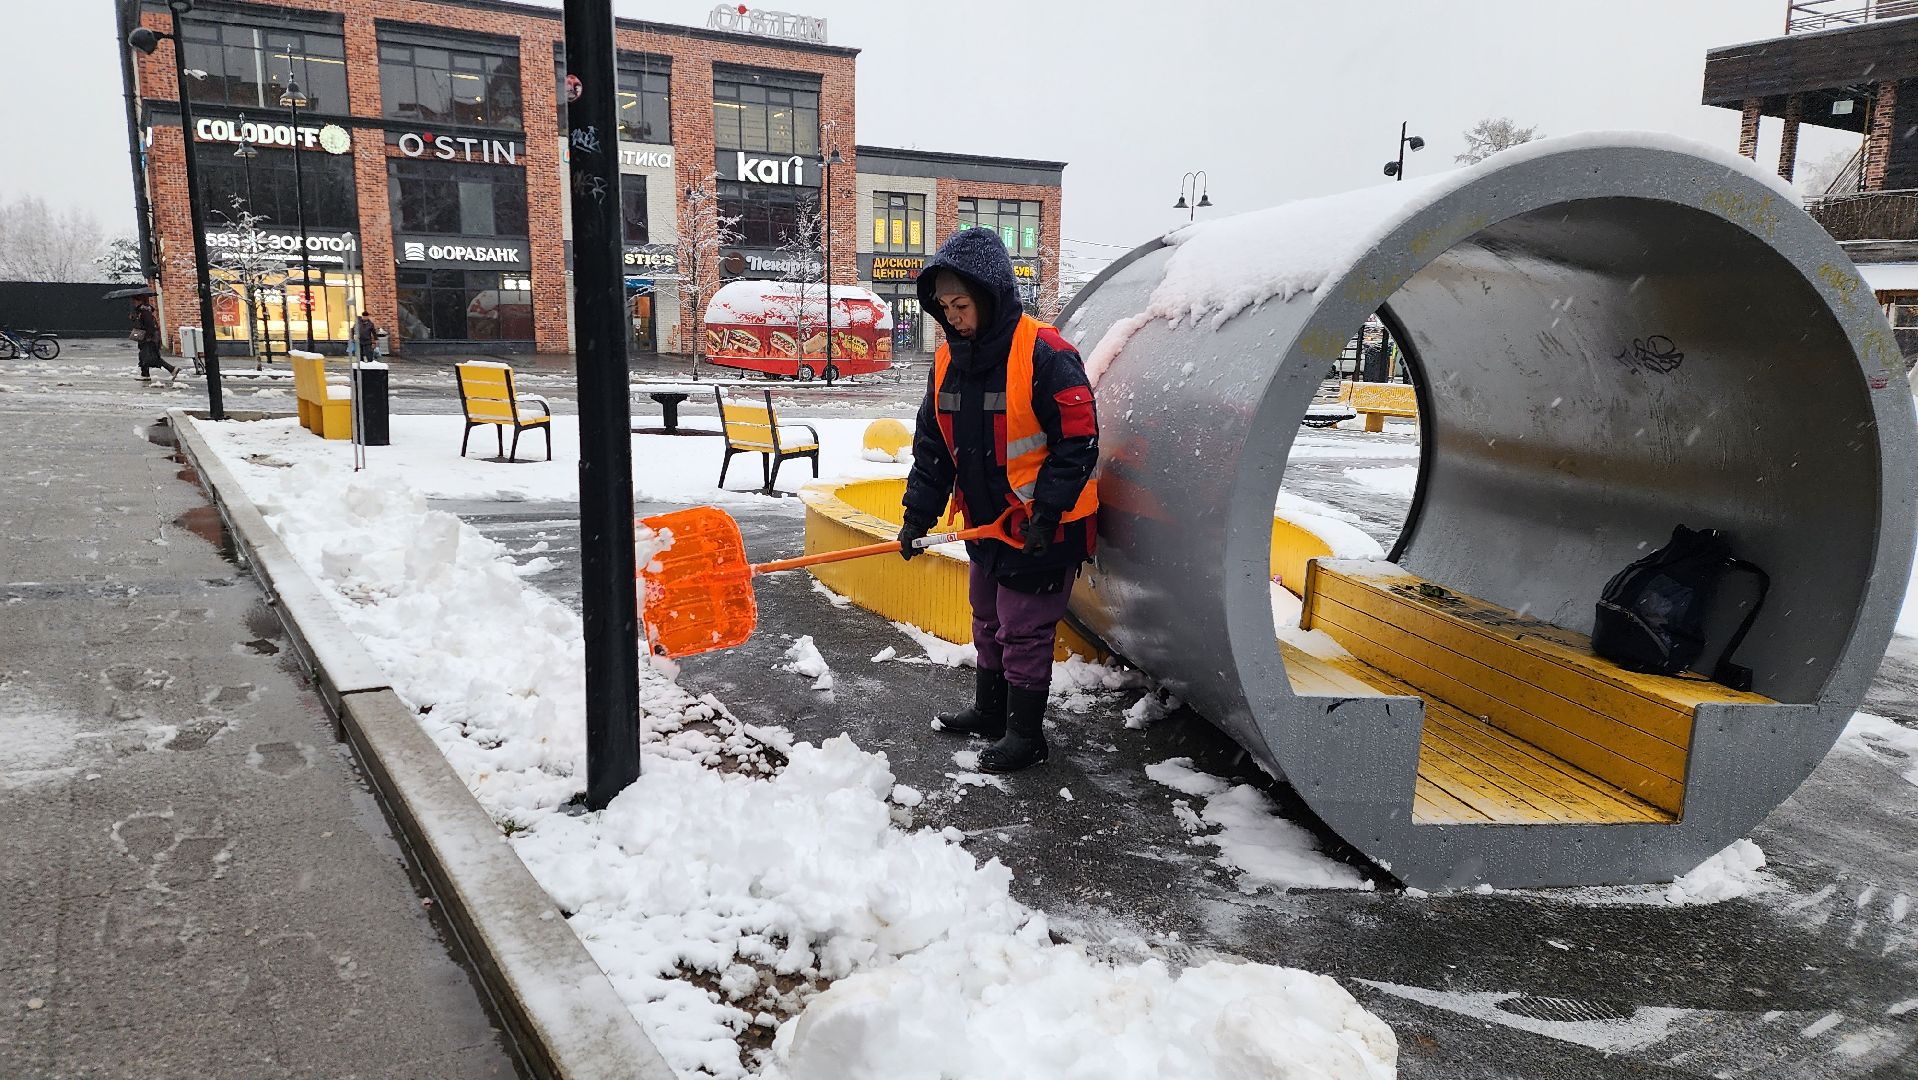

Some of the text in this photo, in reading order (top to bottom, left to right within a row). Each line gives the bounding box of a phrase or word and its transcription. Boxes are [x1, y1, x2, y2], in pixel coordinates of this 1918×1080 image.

[196, 118, 320, 148] COLODOFF
[737, 151, 803, 186] kari
[428, 245, 520, 263] ФОРАБАНК
[624, 253, 675, 268] STIC'S
[873, 257, 925, 269] ДИСКОНТ
[872, 268, 908, 280] ЦЕНТР
[1013, 265, 1035, 277] БУВЬ
